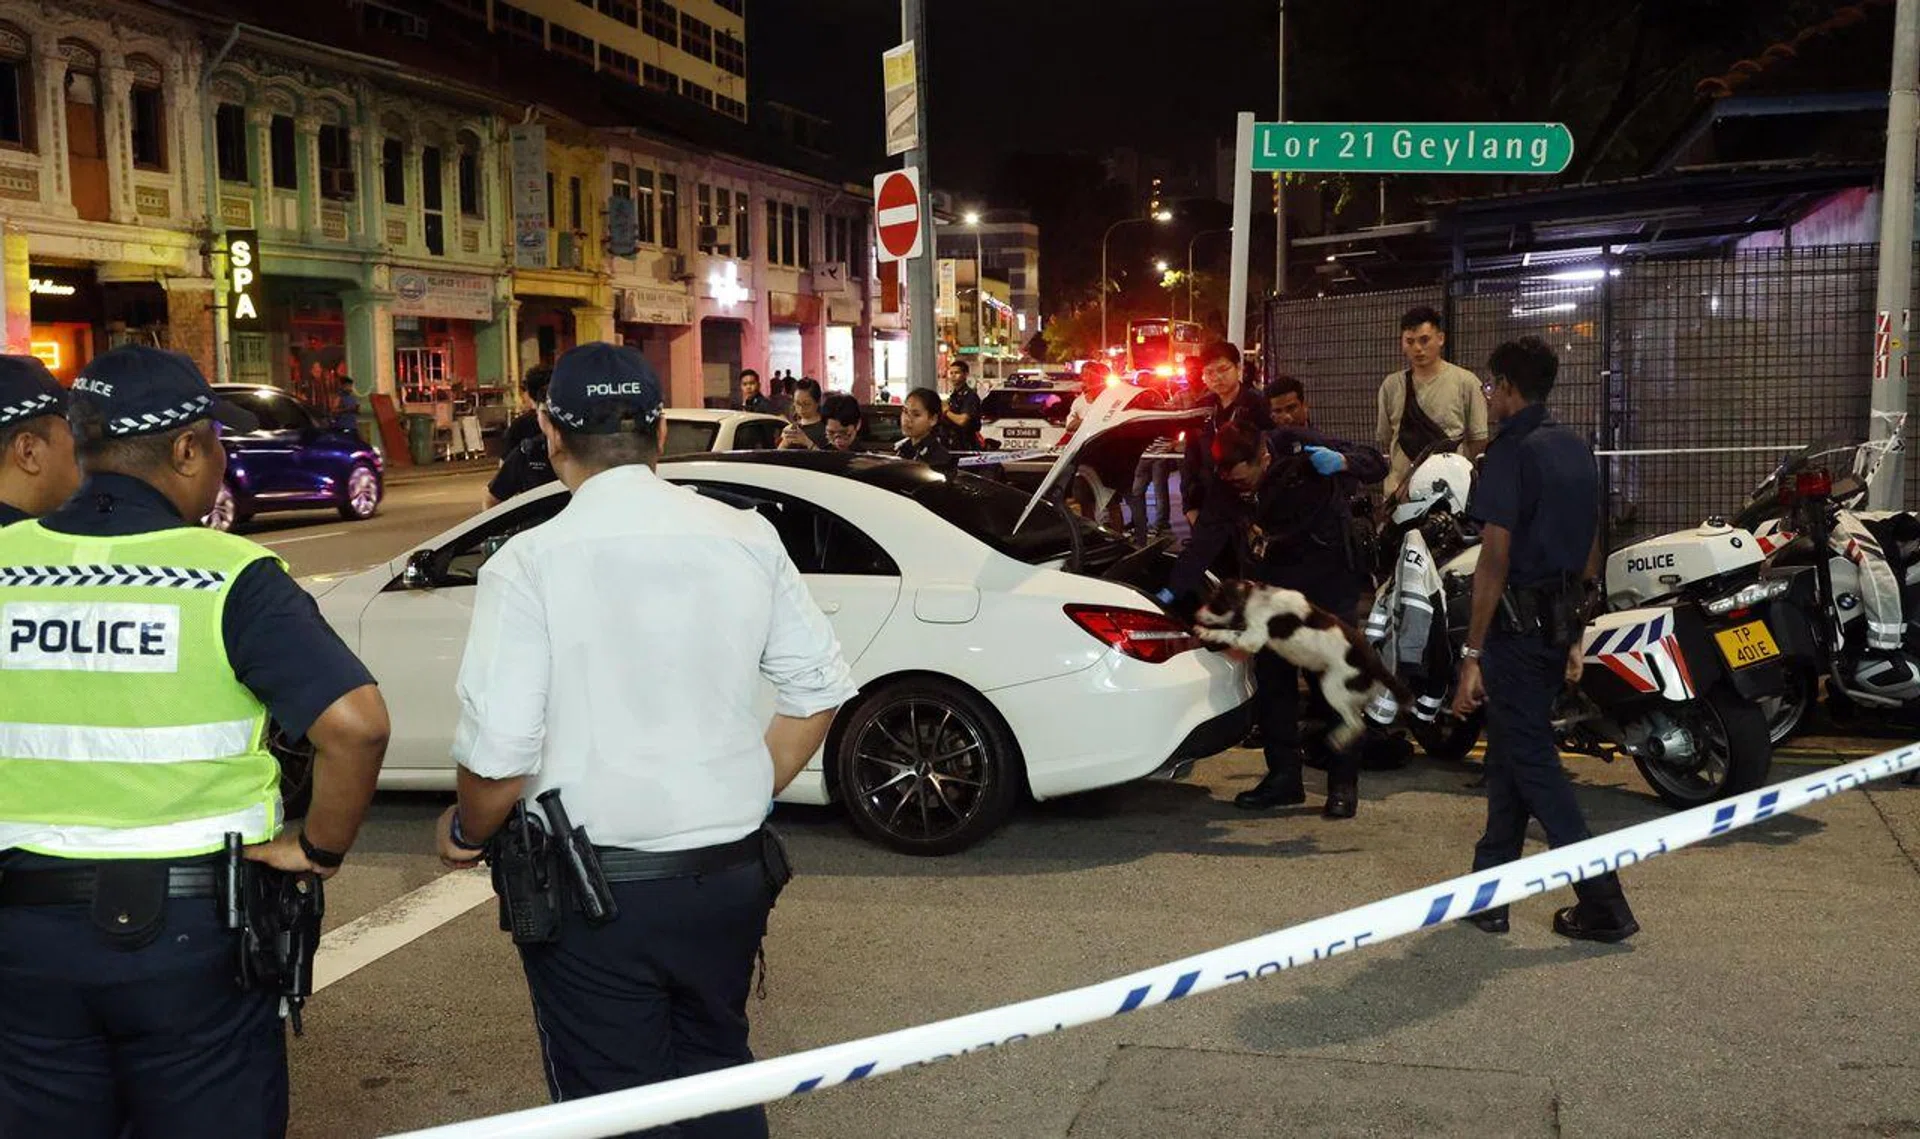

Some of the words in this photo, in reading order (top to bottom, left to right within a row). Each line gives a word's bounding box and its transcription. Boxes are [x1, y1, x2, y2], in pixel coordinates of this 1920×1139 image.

[1263, 129, 1320, 158] Lor
[1339, 131, 1374, 158] 21
[1392, 129, 1549, 168] Geylang
[230, 240, 257, 320] SPA
[586, 382, 642, 397] POLICE
[1003, 439, 1039, 449] POLICE
[1627, 553, 1675, 573] POLICE
[11, 619, 166, 655] POLICE
[1733, 626, 1752, 645] TP
[1736, 640, 1770, 662] 401E
